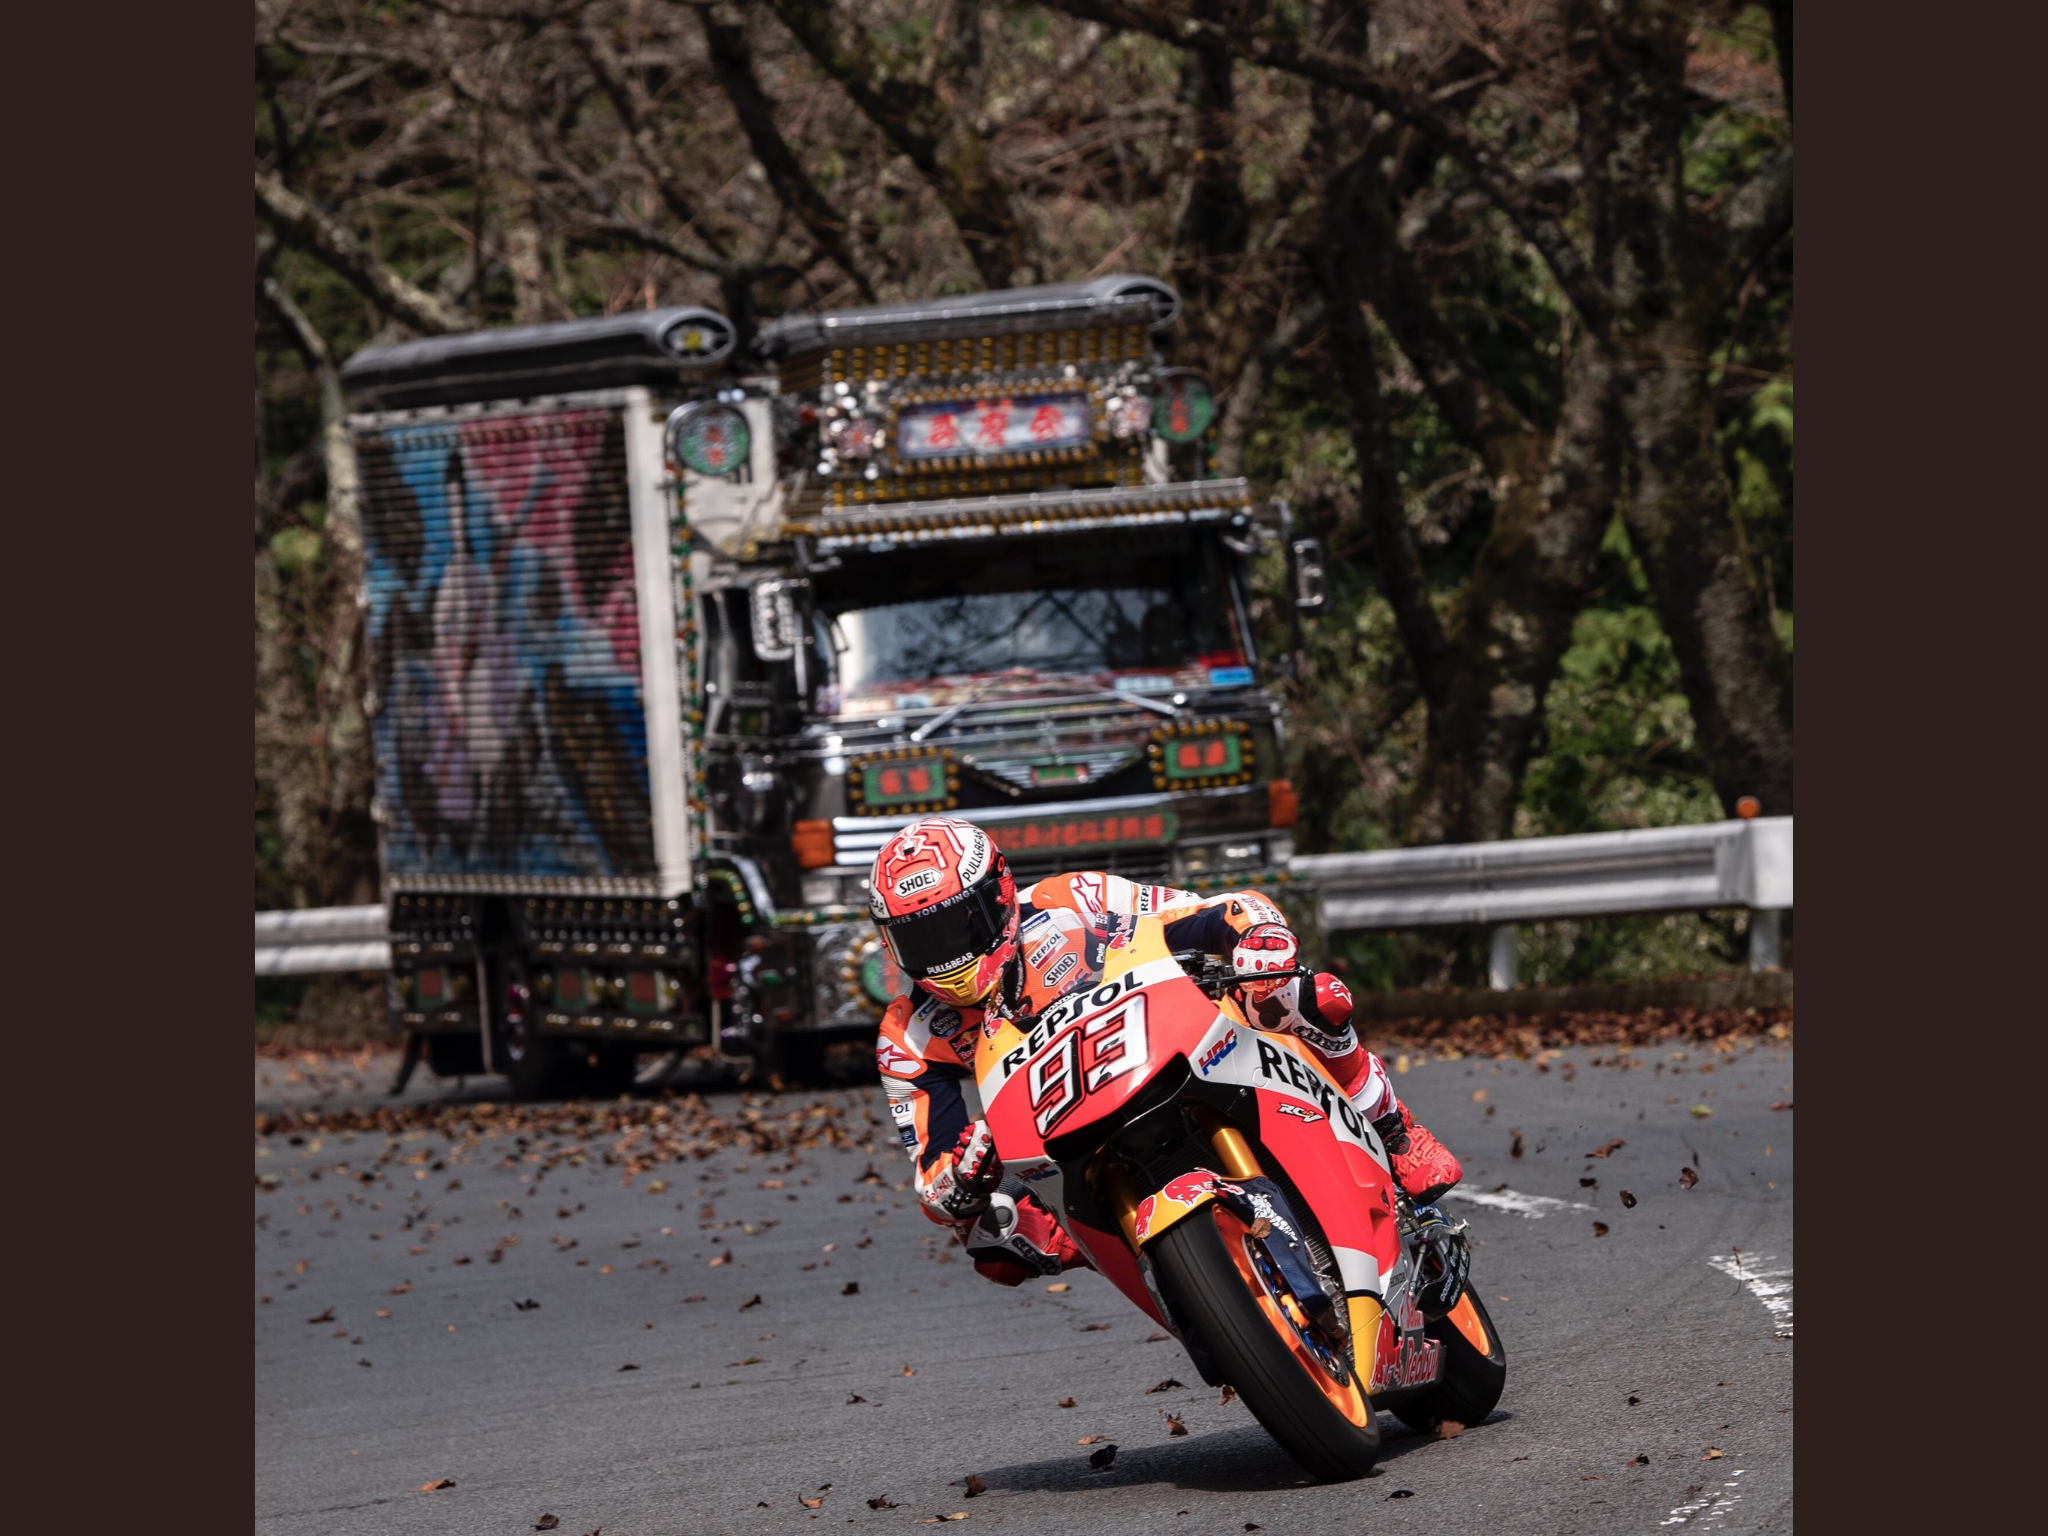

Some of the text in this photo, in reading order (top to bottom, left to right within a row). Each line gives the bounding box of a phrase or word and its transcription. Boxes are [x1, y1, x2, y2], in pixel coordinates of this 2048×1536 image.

[962, 829, 986, 882] PULL&BEAR
[899, 872, 936, 895] SHOEI
[886, 886, 977, 927] GIVES YOU WINGS
[926, 952, 975, 975] PULL&BEAR
[1030, 933, 1061, 965] REPSOL
[1046, 955, 1075, 984] SHOEI
[1040, 992, 1081, 1020] HONDA
[1003, 971, 1143, 1079] REPSOL
[1028, 992, 1148, 1139] 93
[1198, 1027, 1238, 1076] HRC
[890, 1103, 911, 1115] OL
[1256, 1038, 1379, 1156] REPSOL
